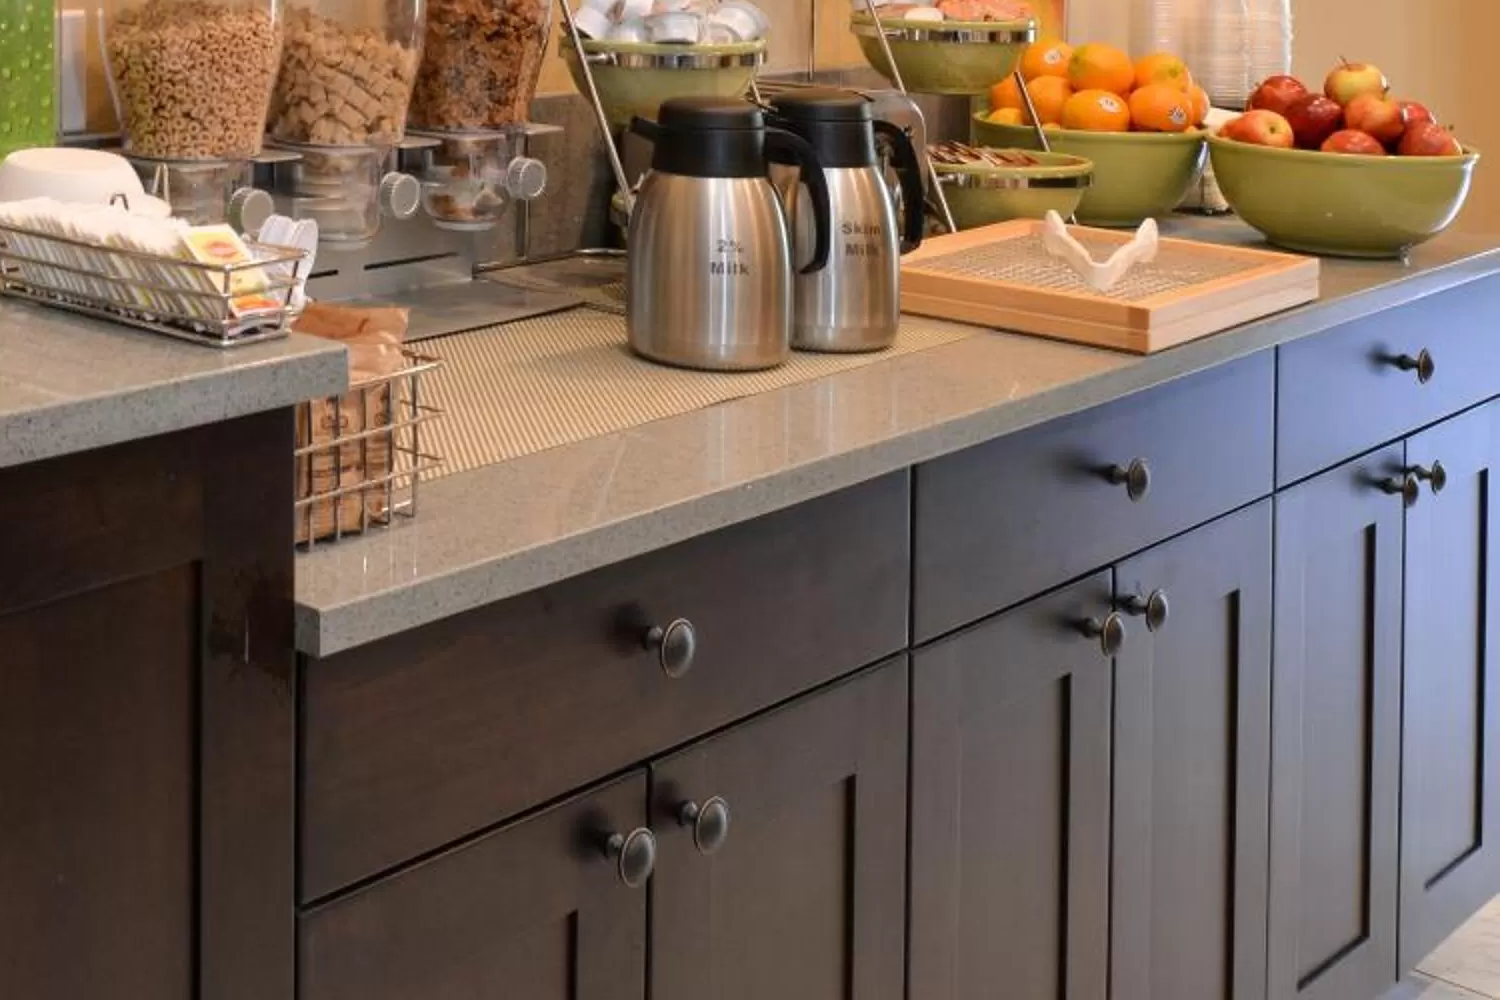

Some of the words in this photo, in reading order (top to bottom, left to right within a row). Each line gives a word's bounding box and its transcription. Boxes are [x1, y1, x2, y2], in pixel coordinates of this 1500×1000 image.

[841, 221, 881, 236] Skim
[845, 243, 881, 257] Milk
[710, 261, 750, 275] Milk
